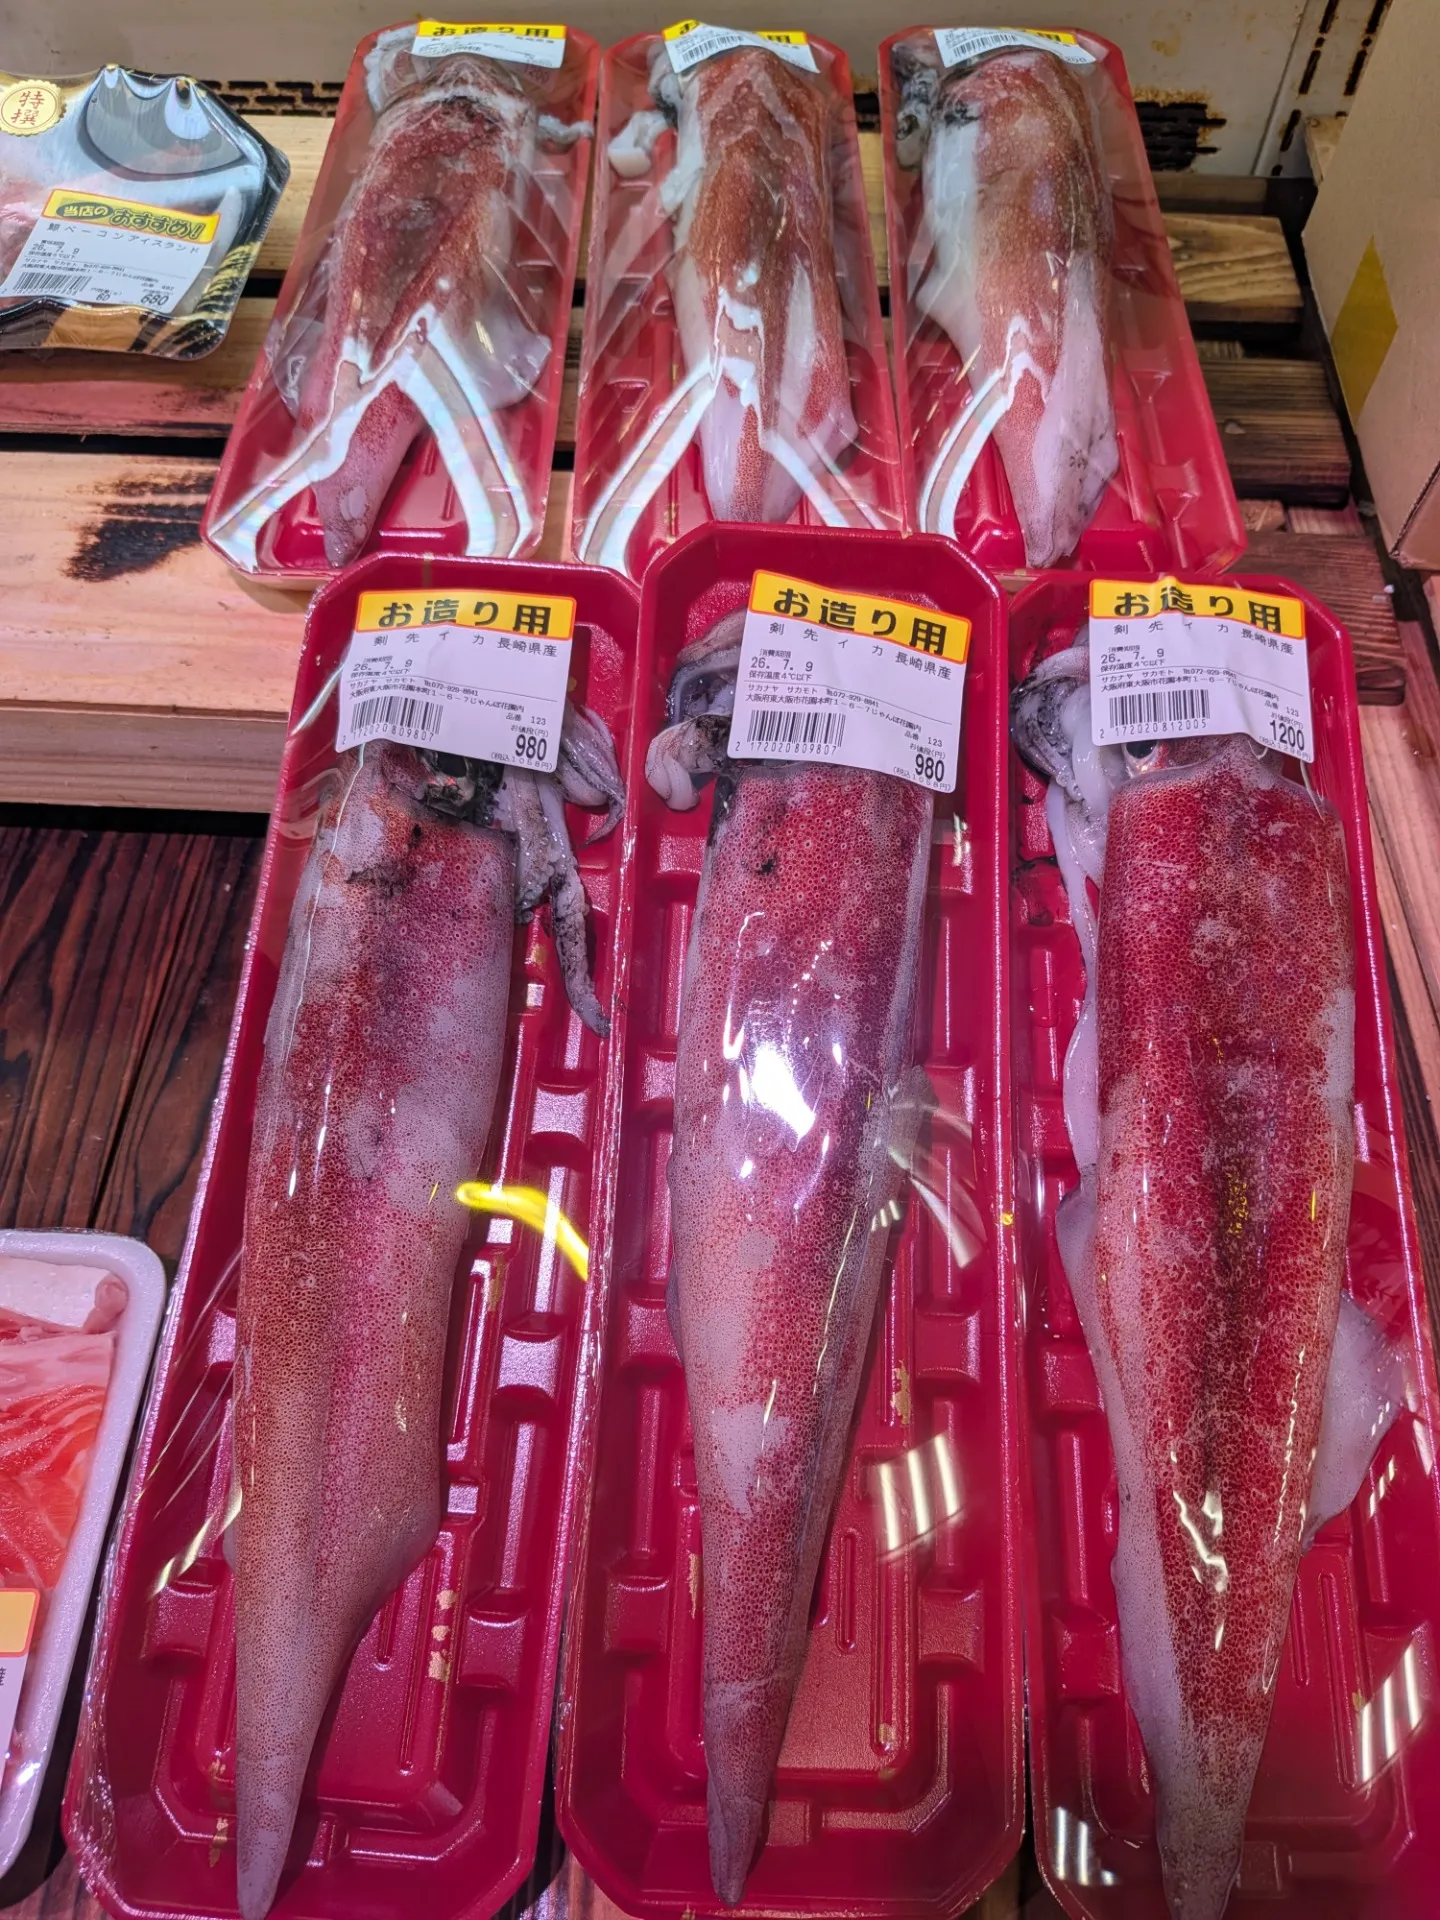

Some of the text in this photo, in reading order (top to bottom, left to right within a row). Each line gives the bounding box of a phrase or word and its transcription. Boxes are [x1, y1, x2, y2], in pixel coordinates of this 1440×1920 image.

[378, 598, 551, 636] お造り用
[773, 588, 947, 656] お造り用
[1113, 586, 1281, 634] お造り用
[497, 637, 558, 658] 長崎県産
[1241, 628, 1294, 655] 長崎県産
[895, 652, 952, 680] 長崎県産
[531, 716, 546, 725] 123
[1286, 706, 1300, 717] 123
[515, 734, 547, 761] 980
[928, 737, 942, 747] 123
[1269, 719, 1305, 751] 1200
[915, 753, 944, 782] 980
